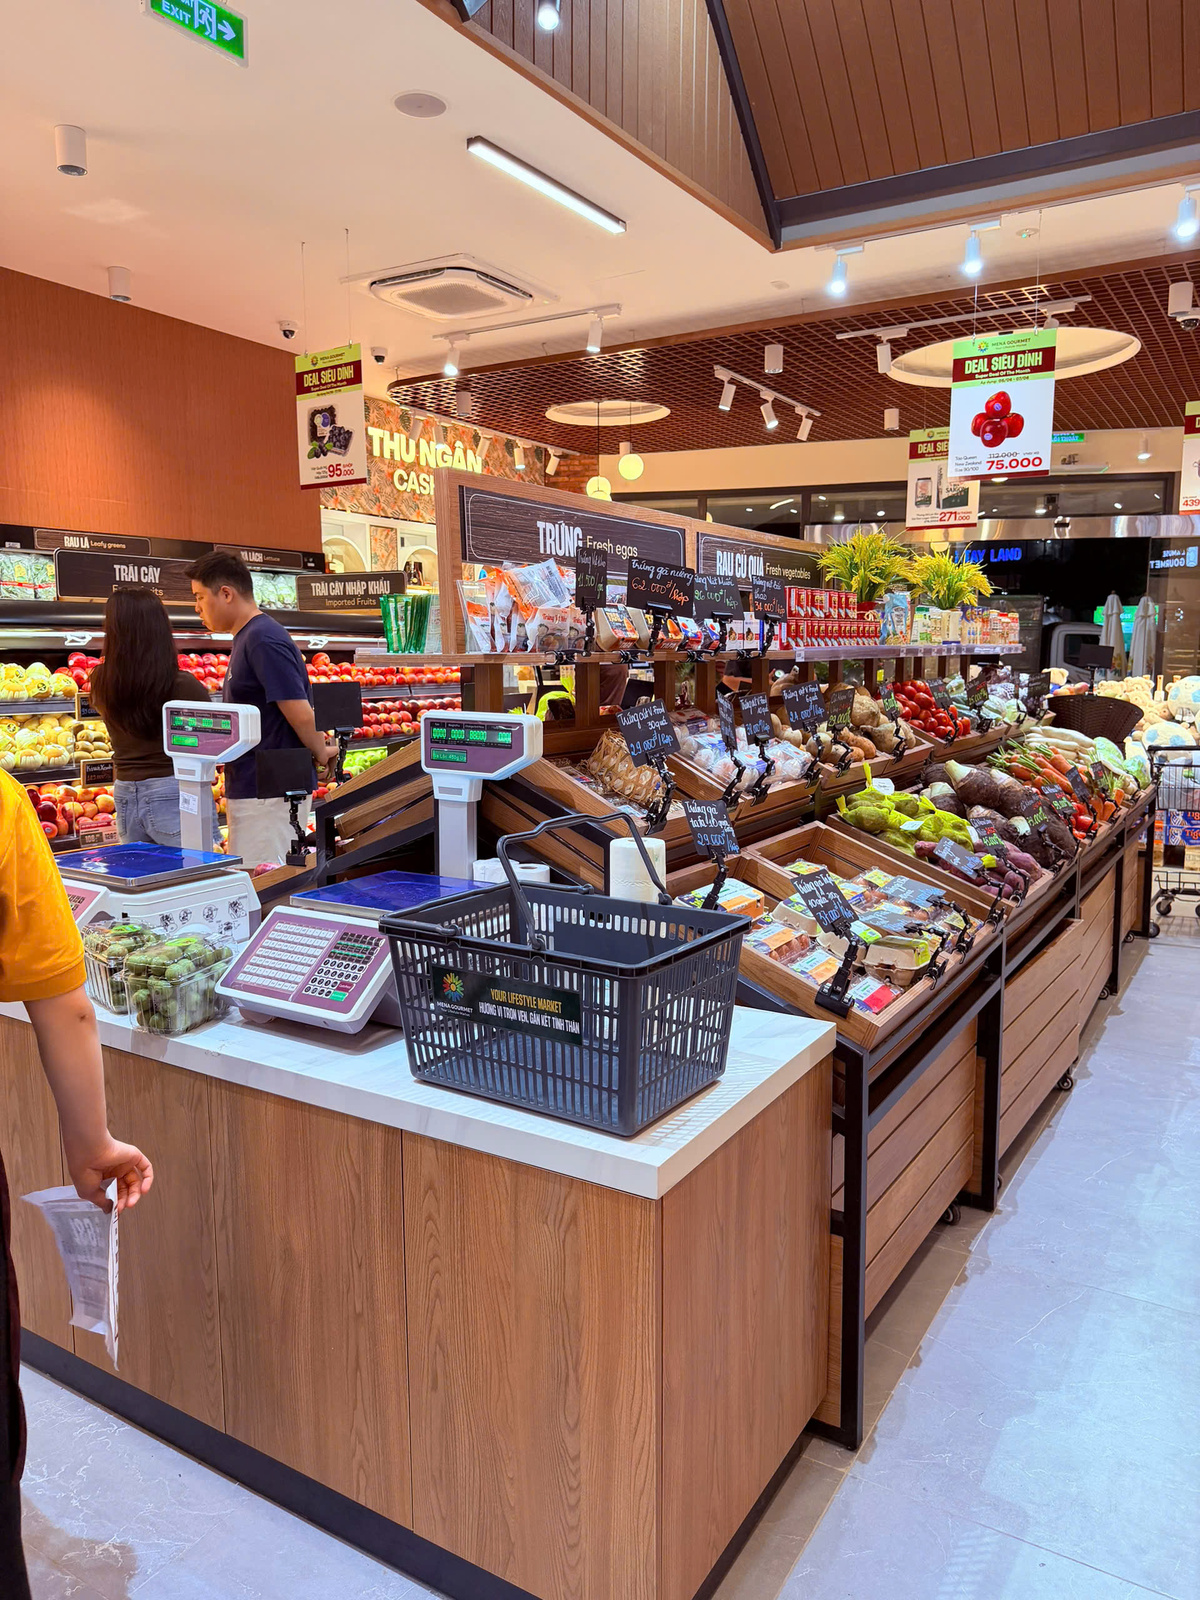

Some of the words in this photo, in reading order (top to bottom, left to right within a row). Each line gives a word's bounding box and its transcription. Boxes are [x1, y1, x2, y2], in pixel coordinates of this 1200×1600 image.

[162, 0, 191, 24] EXIT
[965, 358, 989, 374] DEAL
[991, 354, 1015, 371] SIÊU
[304, 372, 320, 387] DEAL
[321, 368, 336, 384] SIÊU
[368, 426, 416, 463] THU
[420, 438, 482, 473] NGÂN
[918, 442, 935, 454] DEAL
[328, 464, 342, 478] 95
[986, 457, 1042, 470] 75.000
[939, 511, 957, 522] 271
[64, 536, 79, 548] RAU
[90, 540, 106, 550] Leafy
[107, 542, 126, 550] greens
[536, 520, 583, 558] TRỨNG
[586, 536, 615, 554] Fresh
[716, 551, 733, 576] RAU
[735, 549, 747, 578] CỦ
[766, 563, 781, 577] Fresh
[782, 565, 811, 580] vegetables
[990, 548, 1022, 562] LAND
[114, 563, 138, 582] TRÁI
[140, 563, 161, 584] CÂY
[311, 580, 328, 596] TRÁI
[329, 580, 345, 596] CÂY
[346, 580, 367, 598] NHẬP
[368, 577, 391, 595] KHẨU
[325, 599, 355, 608] Imported
[356, 598, 376, 606] Fruits
[451, 1003, 473, 1014] GOURMET
[490, 988, 507, 1003] YOUR
[508, 991, 537, 1009] LIFESTYLE
[538, 997, 562, 1014] MARKET
[478, 1001, 497, 1015] HƯƠNG
[503, 1006, 517, 1022] TRỌN
[552, 1015, 565, 1031] TÌNH
